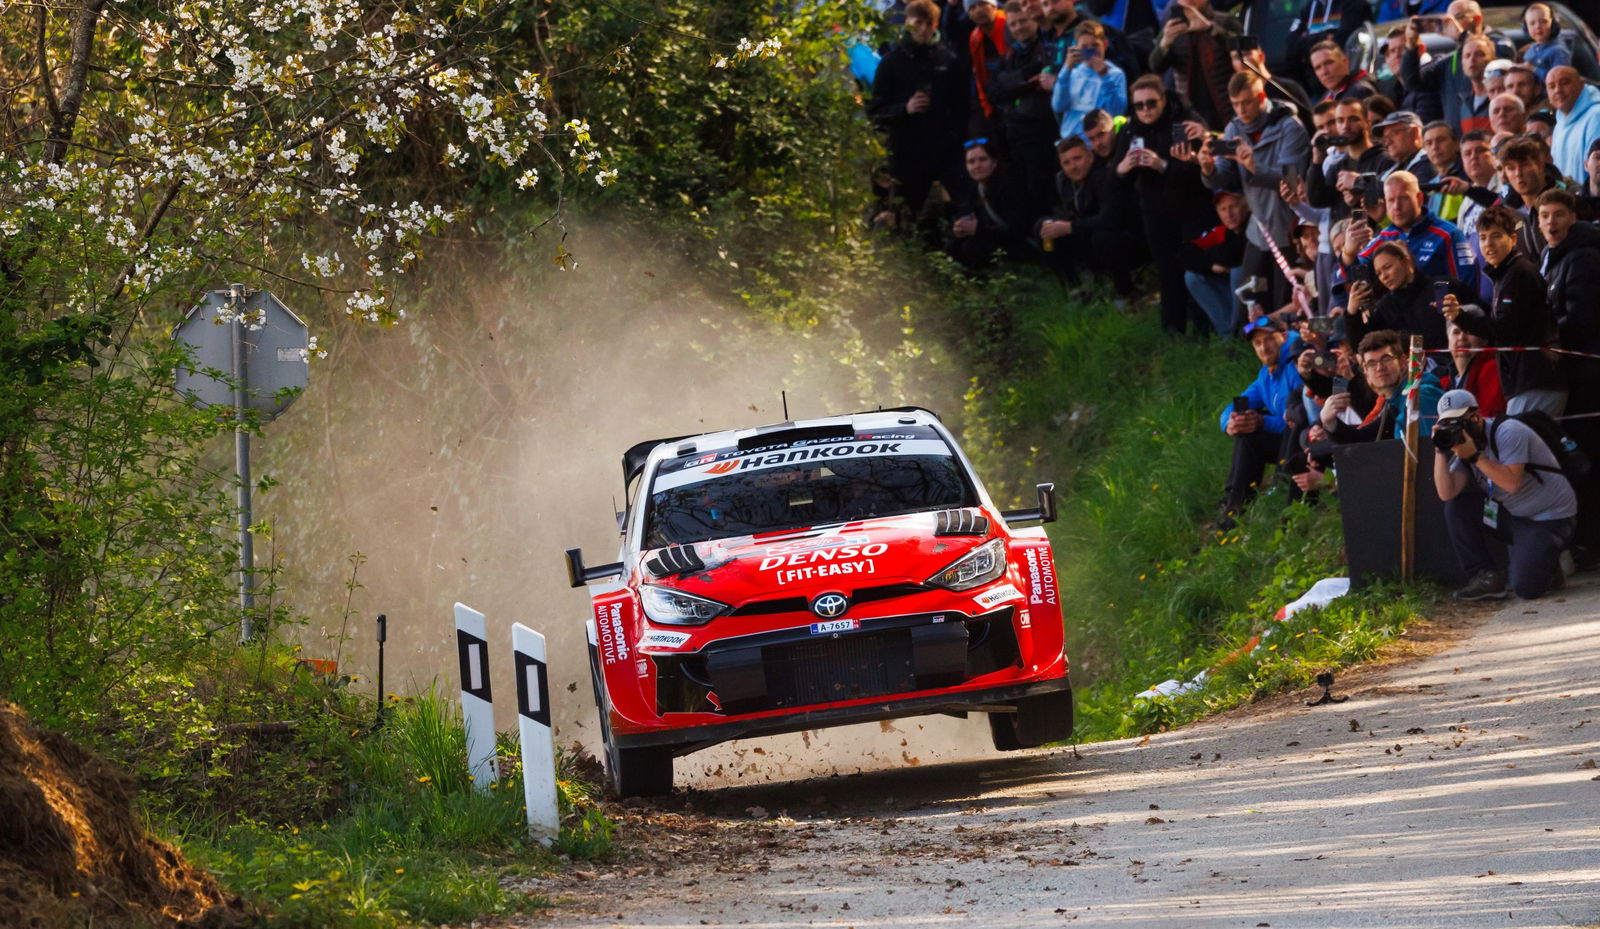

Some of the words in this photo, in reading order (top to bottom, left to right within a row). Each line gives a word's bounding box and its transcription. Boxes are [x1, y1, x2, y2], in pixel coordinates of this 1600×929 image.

[721, 442, 788, 458] TOYOTA
[790, 436, 855, 449] GAZOO
[857, 433, 916, 441] Racing
[758, 543, 889, 571] DENSO
[776, 559, 876, 586] [FIT-EASY]
[1023, 548, 1043, 605] Panasonic
[1037, 546, 1056, 605] AUTOMOTIVE
[597, 605, 616, 665] AUTOMOTIVE
[610, 602, 630, 660] Panasonic
[820, 621, 851, 632] A-7657
